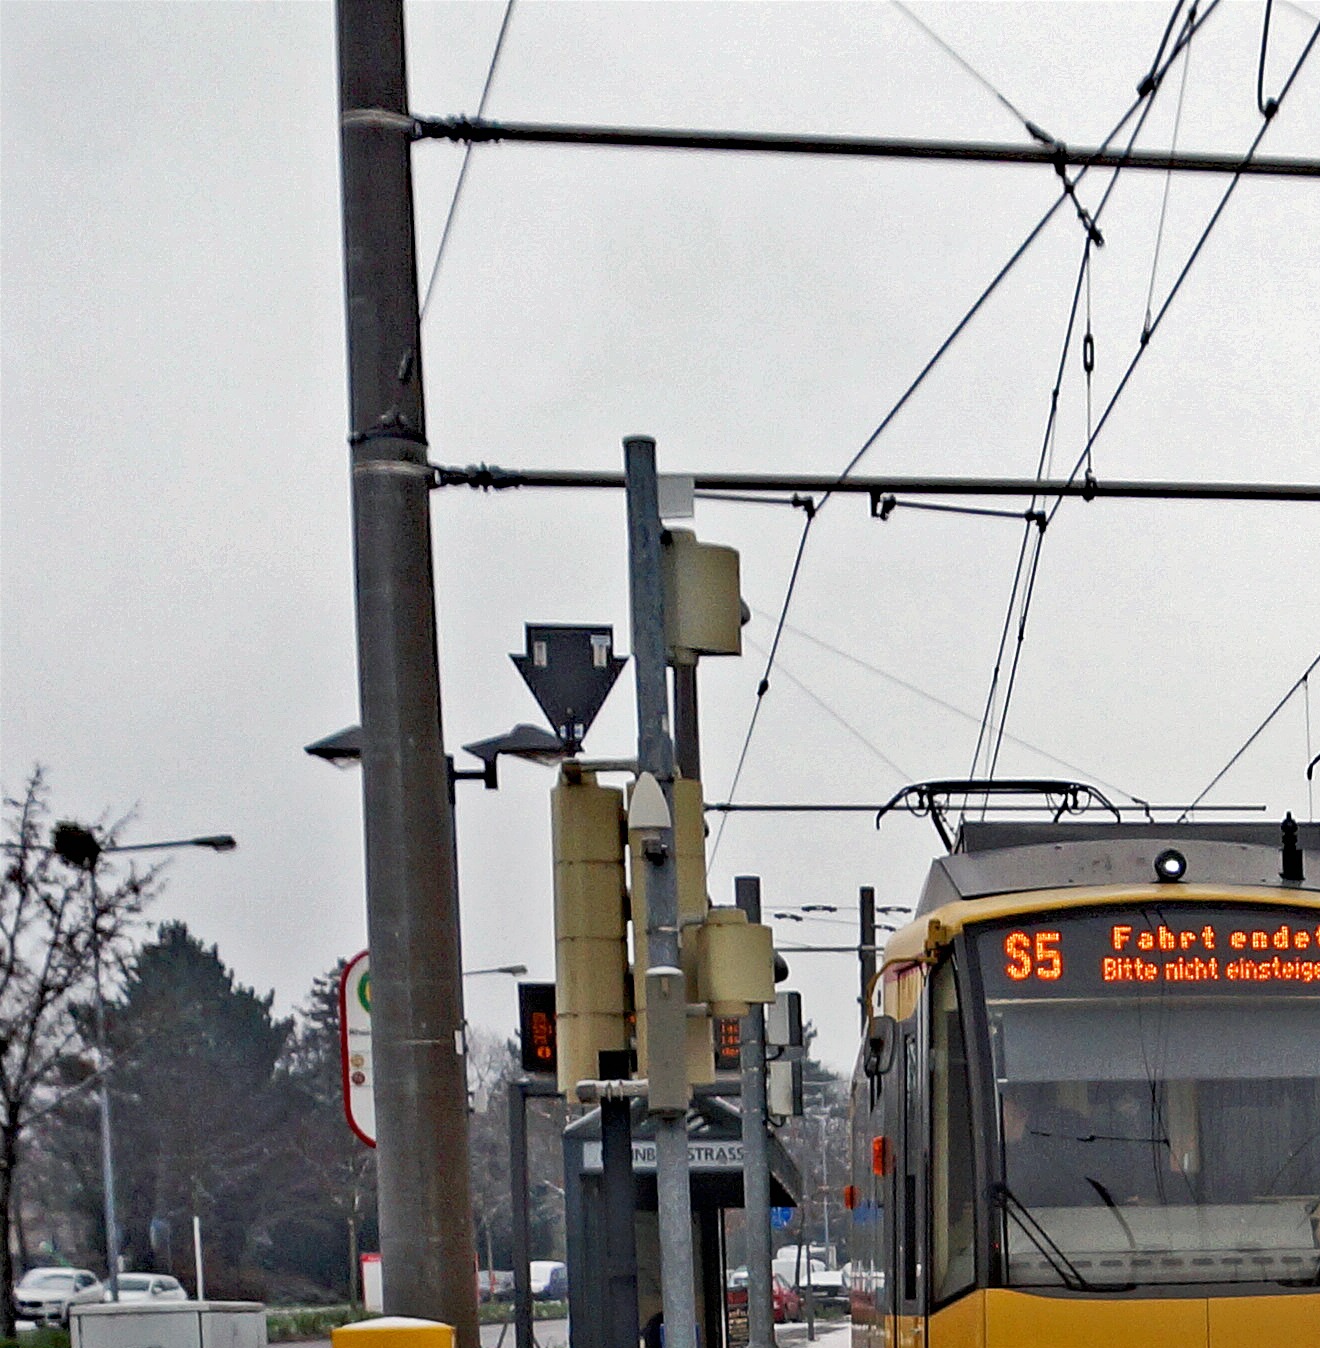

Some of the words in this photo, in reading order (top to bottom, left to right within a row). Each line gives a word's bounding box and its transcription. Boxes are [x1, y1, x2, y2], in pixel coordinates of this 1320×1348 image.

[1112, 925, 1215, 950] Fahrt
[1004, 930, 1062, 981] S5
[1103, 957, 1158, 982] Bitte
[1164, 957, 1220, 981] nicht
